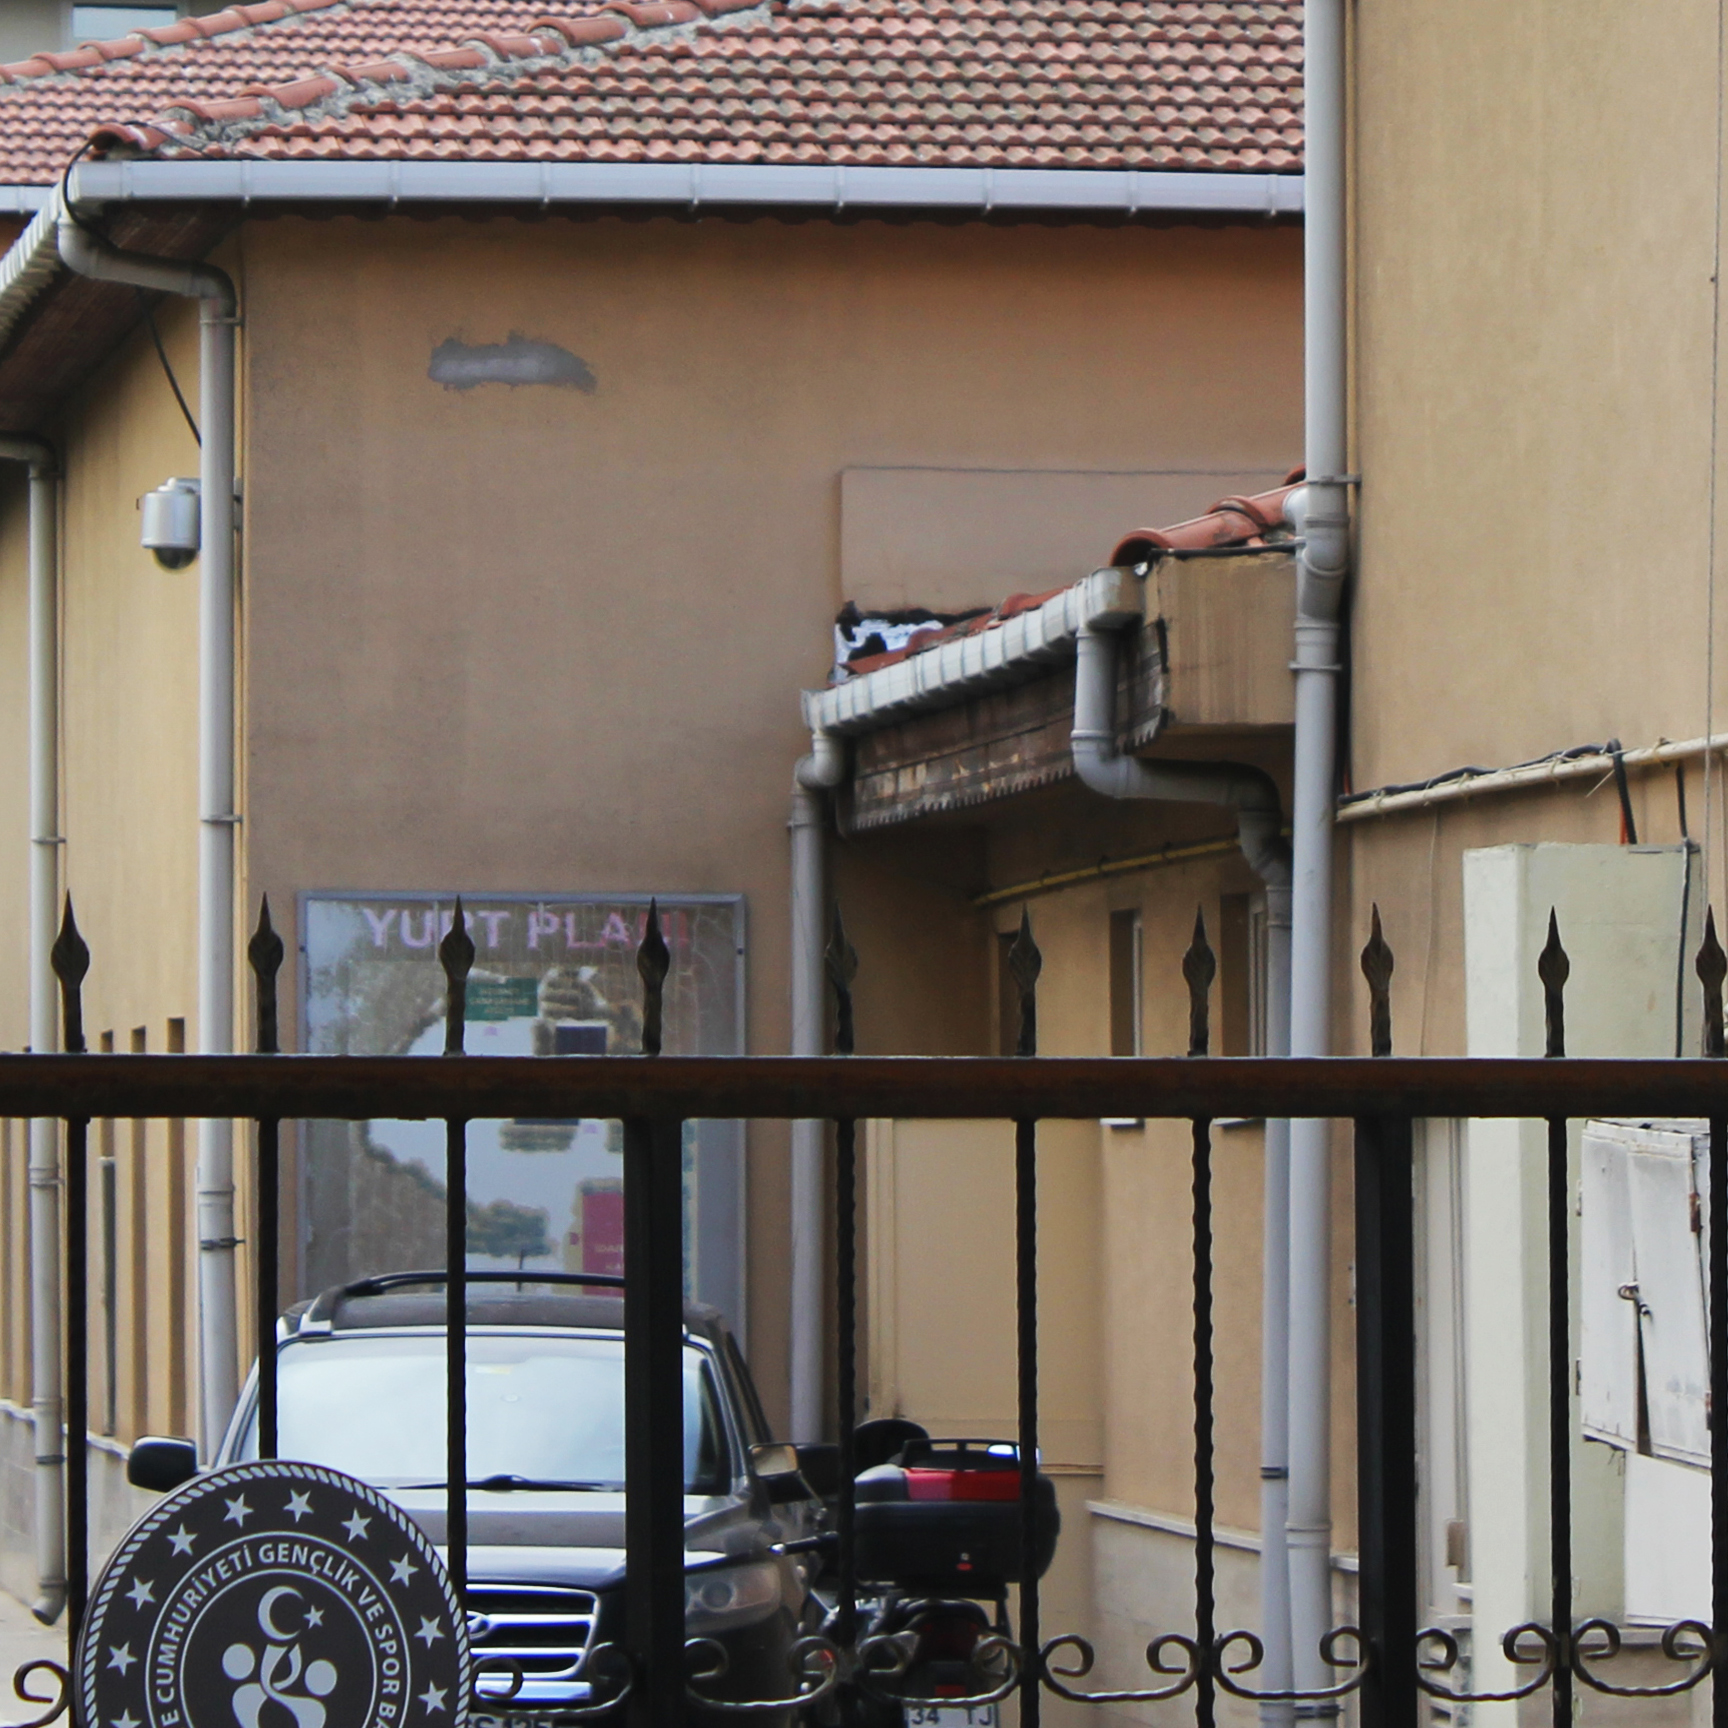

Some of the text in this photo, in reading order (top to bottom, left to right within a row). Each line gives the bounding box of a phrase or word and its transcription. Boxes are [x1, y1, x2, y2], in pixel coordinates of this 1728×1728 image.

[156, 1543, 401, 1704] CUMHURİYETİ GENÇLİK VE SPOR
